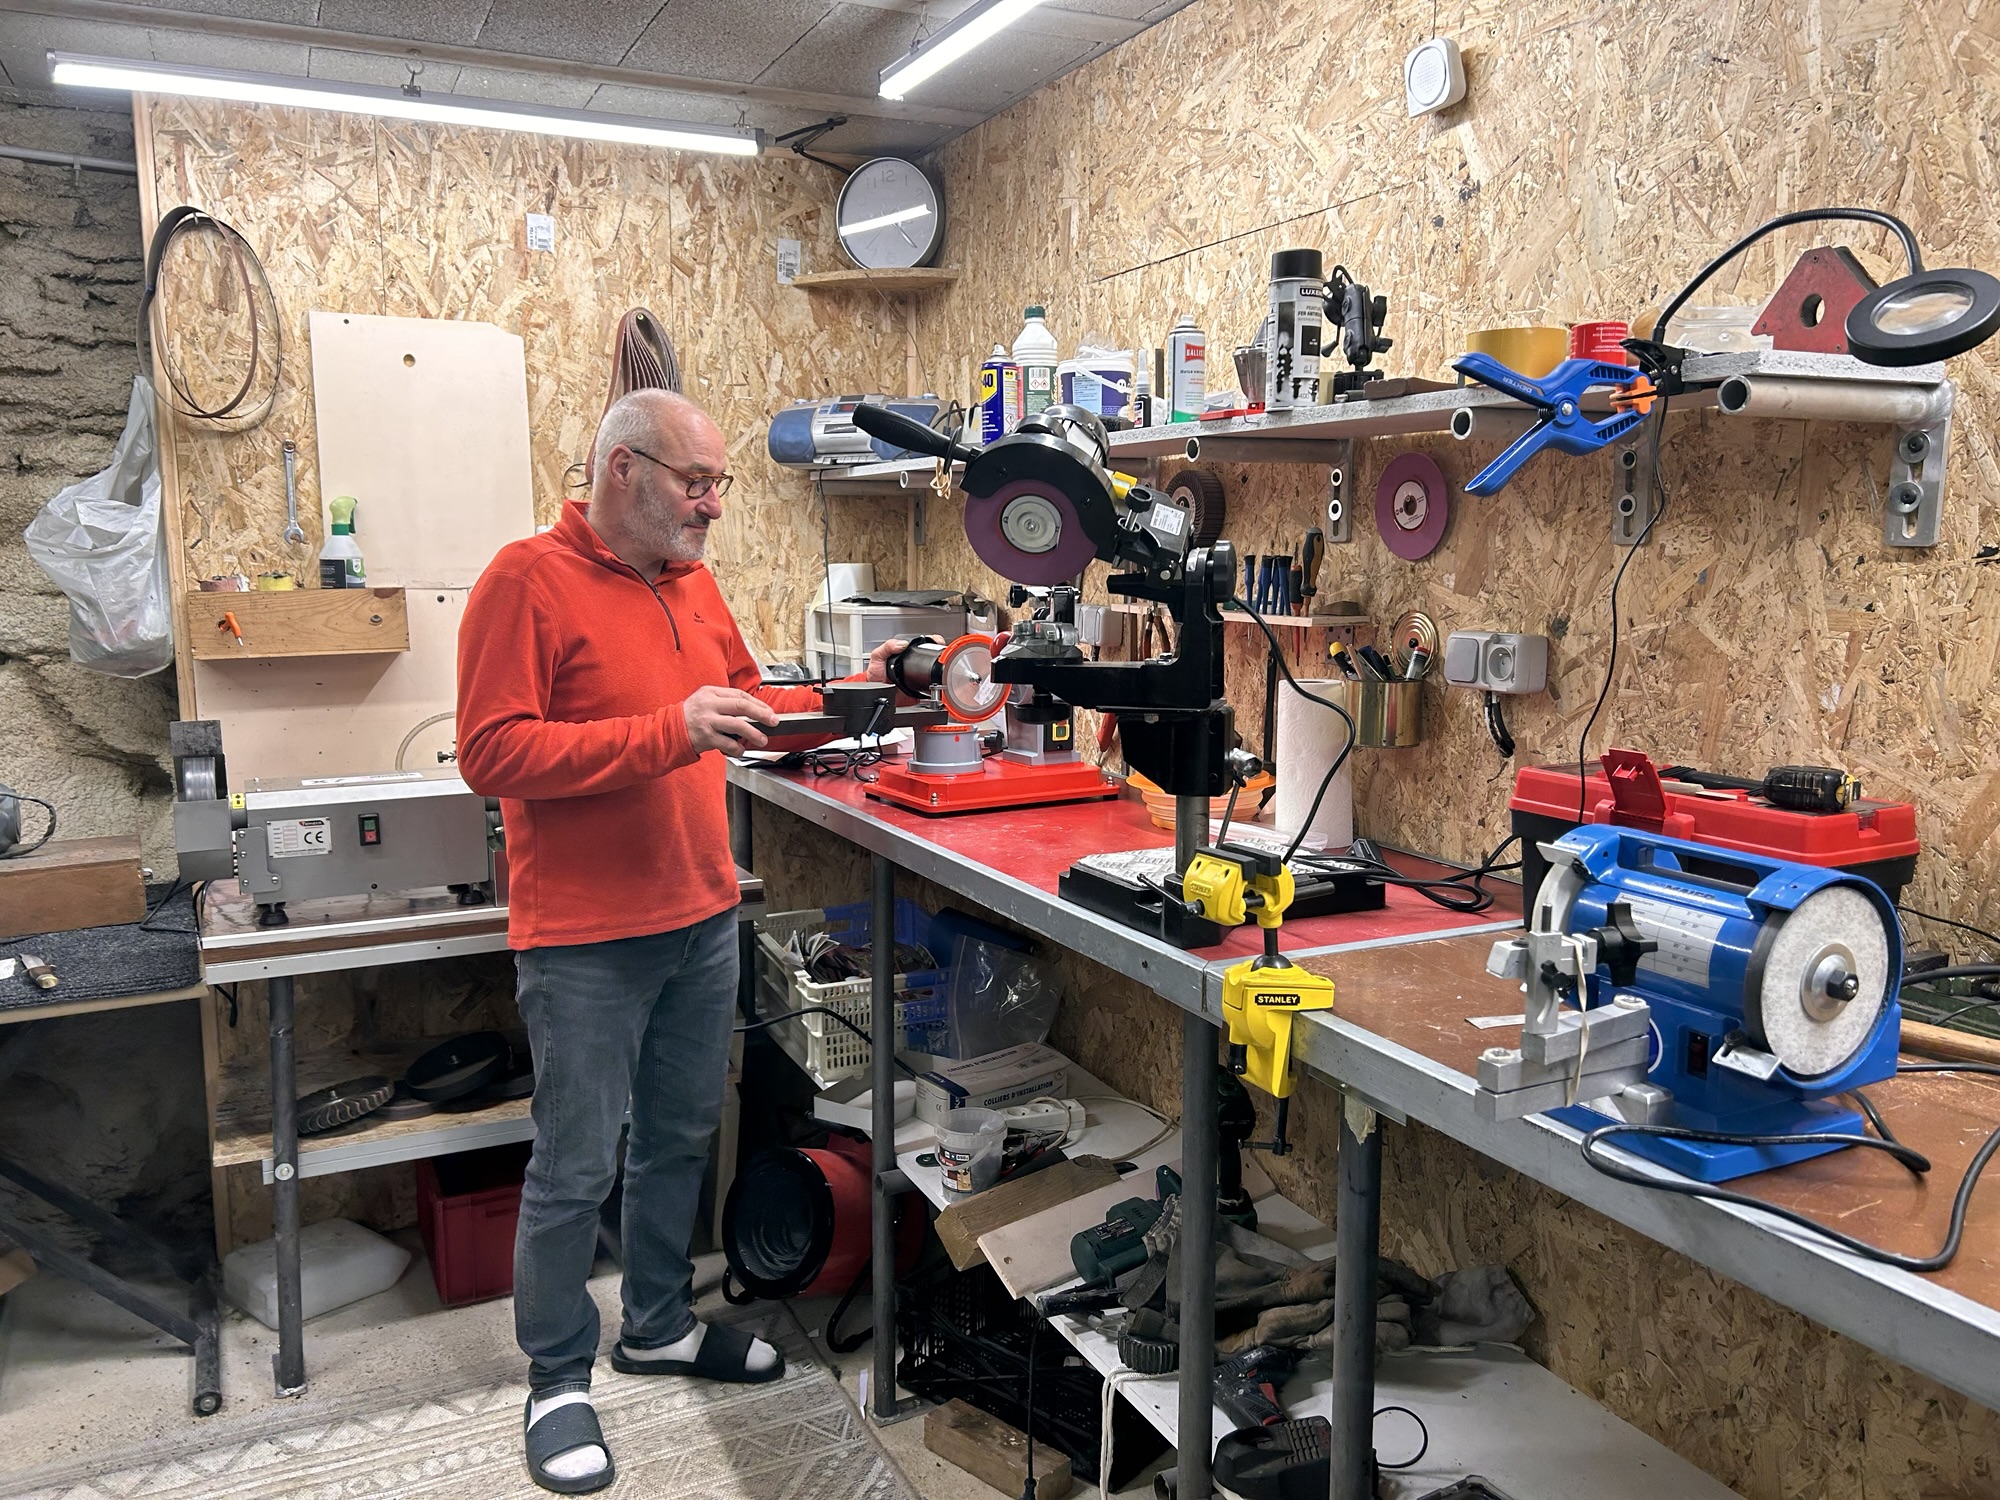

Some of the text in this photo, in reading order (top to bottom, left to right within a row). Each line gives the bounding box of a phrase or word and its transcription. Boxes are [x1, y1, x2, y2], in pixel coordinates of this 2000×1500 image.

[881, 169, 895, 183] 12
[866, 177, 877, 189] 11
[1186, 347, 1205, 357] BALLIS
[1502, 376, 1533, 394] DEXTER
[304, 831, 324, 844] CE
[1257, 996, 1298, 1004] STANLEY
[947, 1049, 1018, 1073] COLLIERS D'INSTALLATION
[983, 1080, 1054, 1107] COLLIERS D'INSTALLATION
